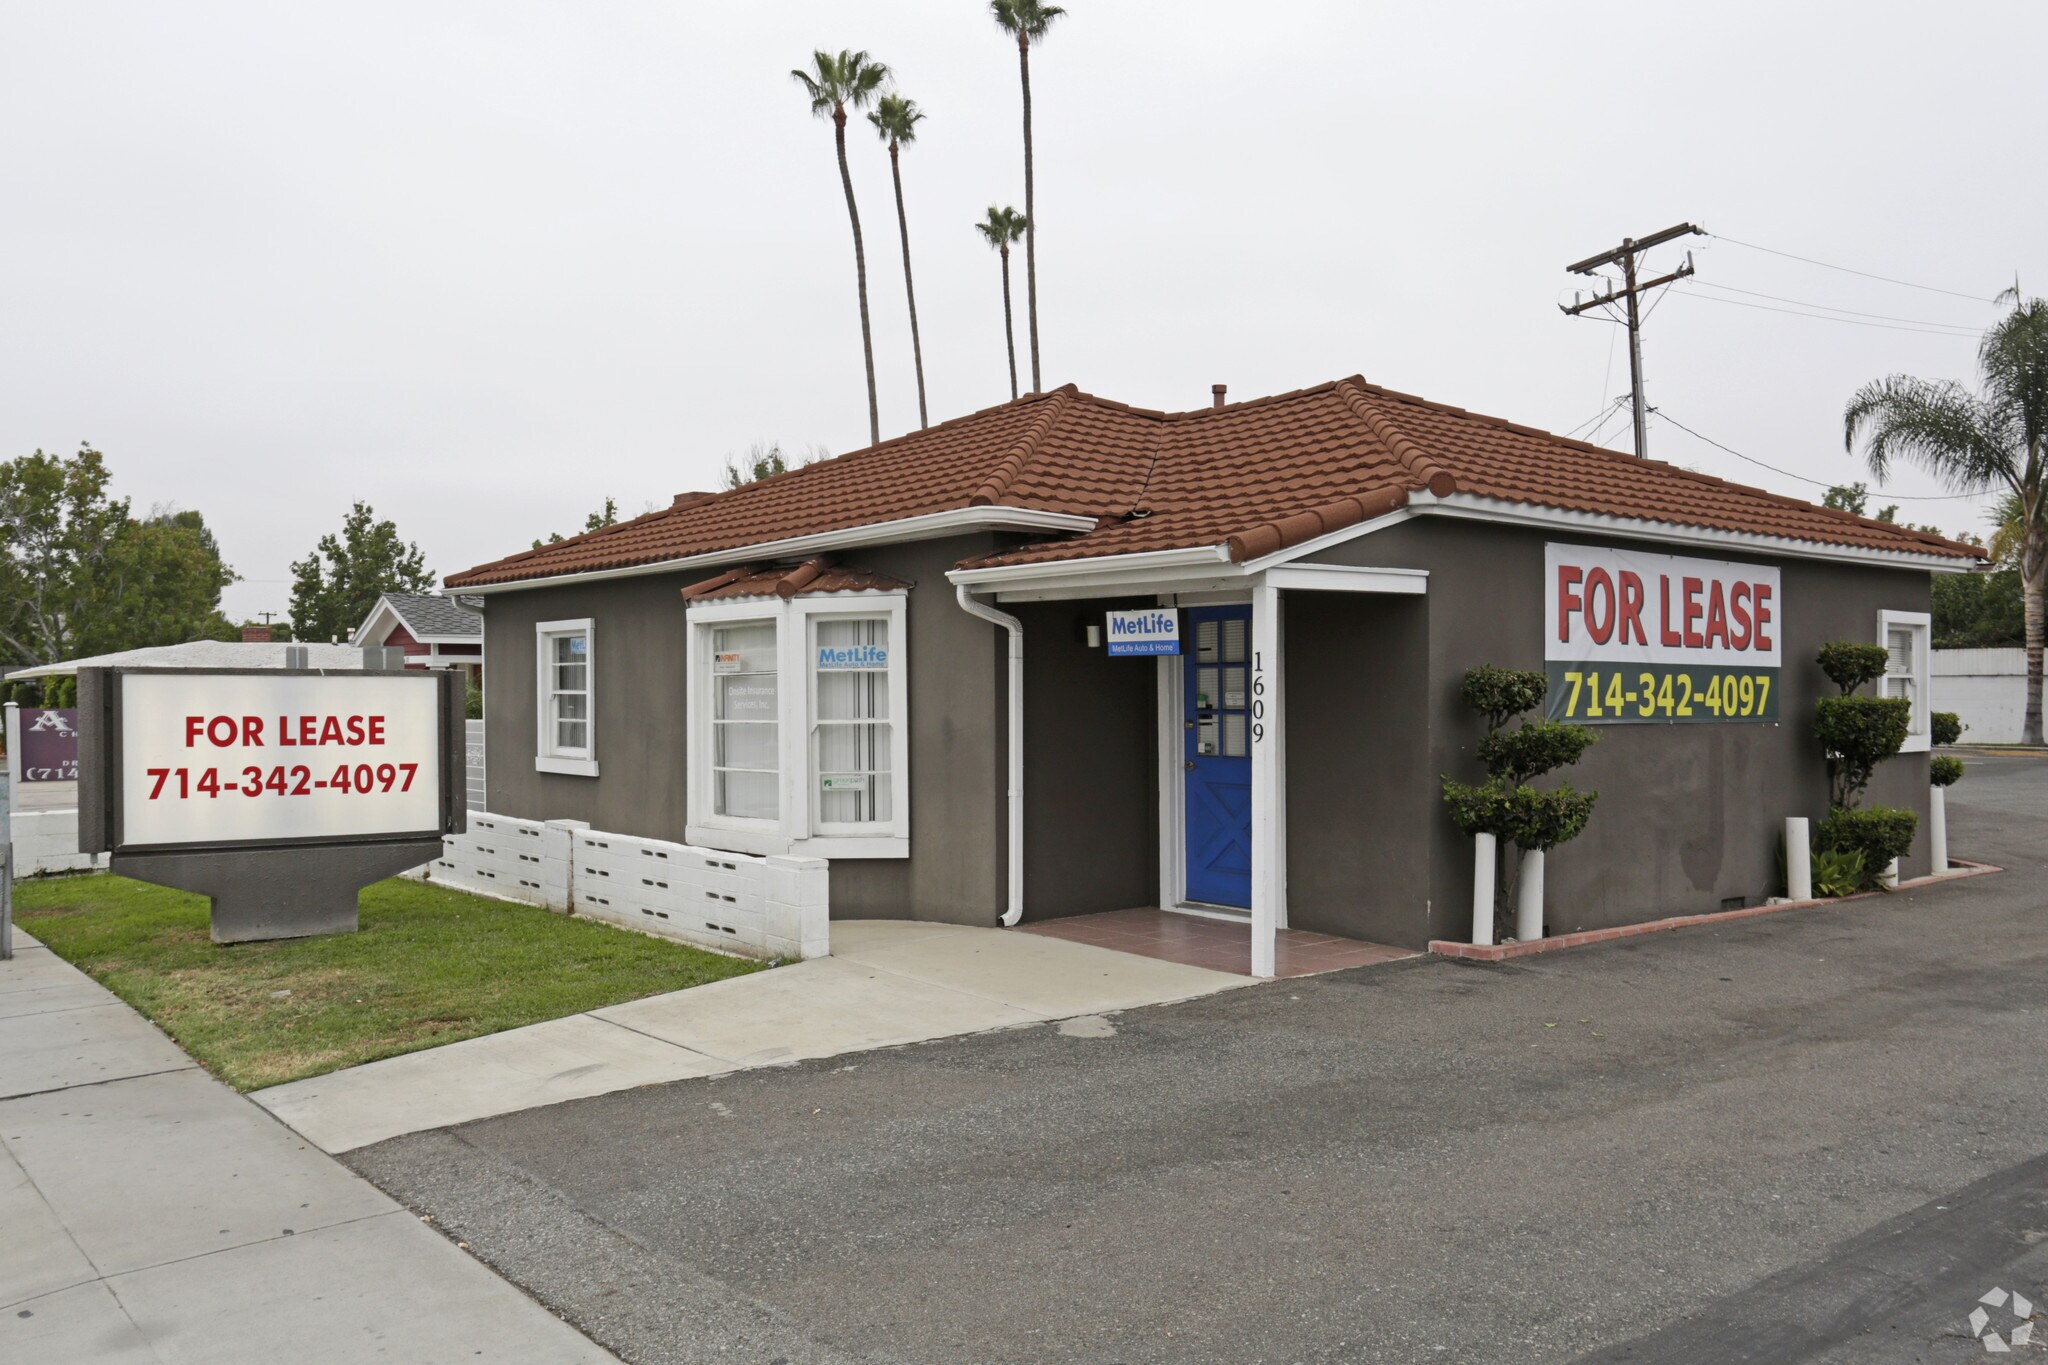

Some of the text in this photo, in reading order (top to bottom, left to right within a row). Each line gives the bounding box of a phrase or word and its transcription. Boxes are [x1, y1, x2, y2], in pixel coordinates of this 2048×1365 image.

[1112, 613, 1174, 635] MetLife
[1558, 564, 1772, 652] FOR LEASE
[819, 645, 887, 662] MetLife
[1112, 644, 1134, 653] MetLife
[1149, 643, 1154, 652] &
[1253, 652, 1265, 743] 1609
[1564, 672, 1771, 717] 714-342-4097
[185, 715, 385, 747] FOR LEASE
[147, 763, 419, 800] 714-342-4097
